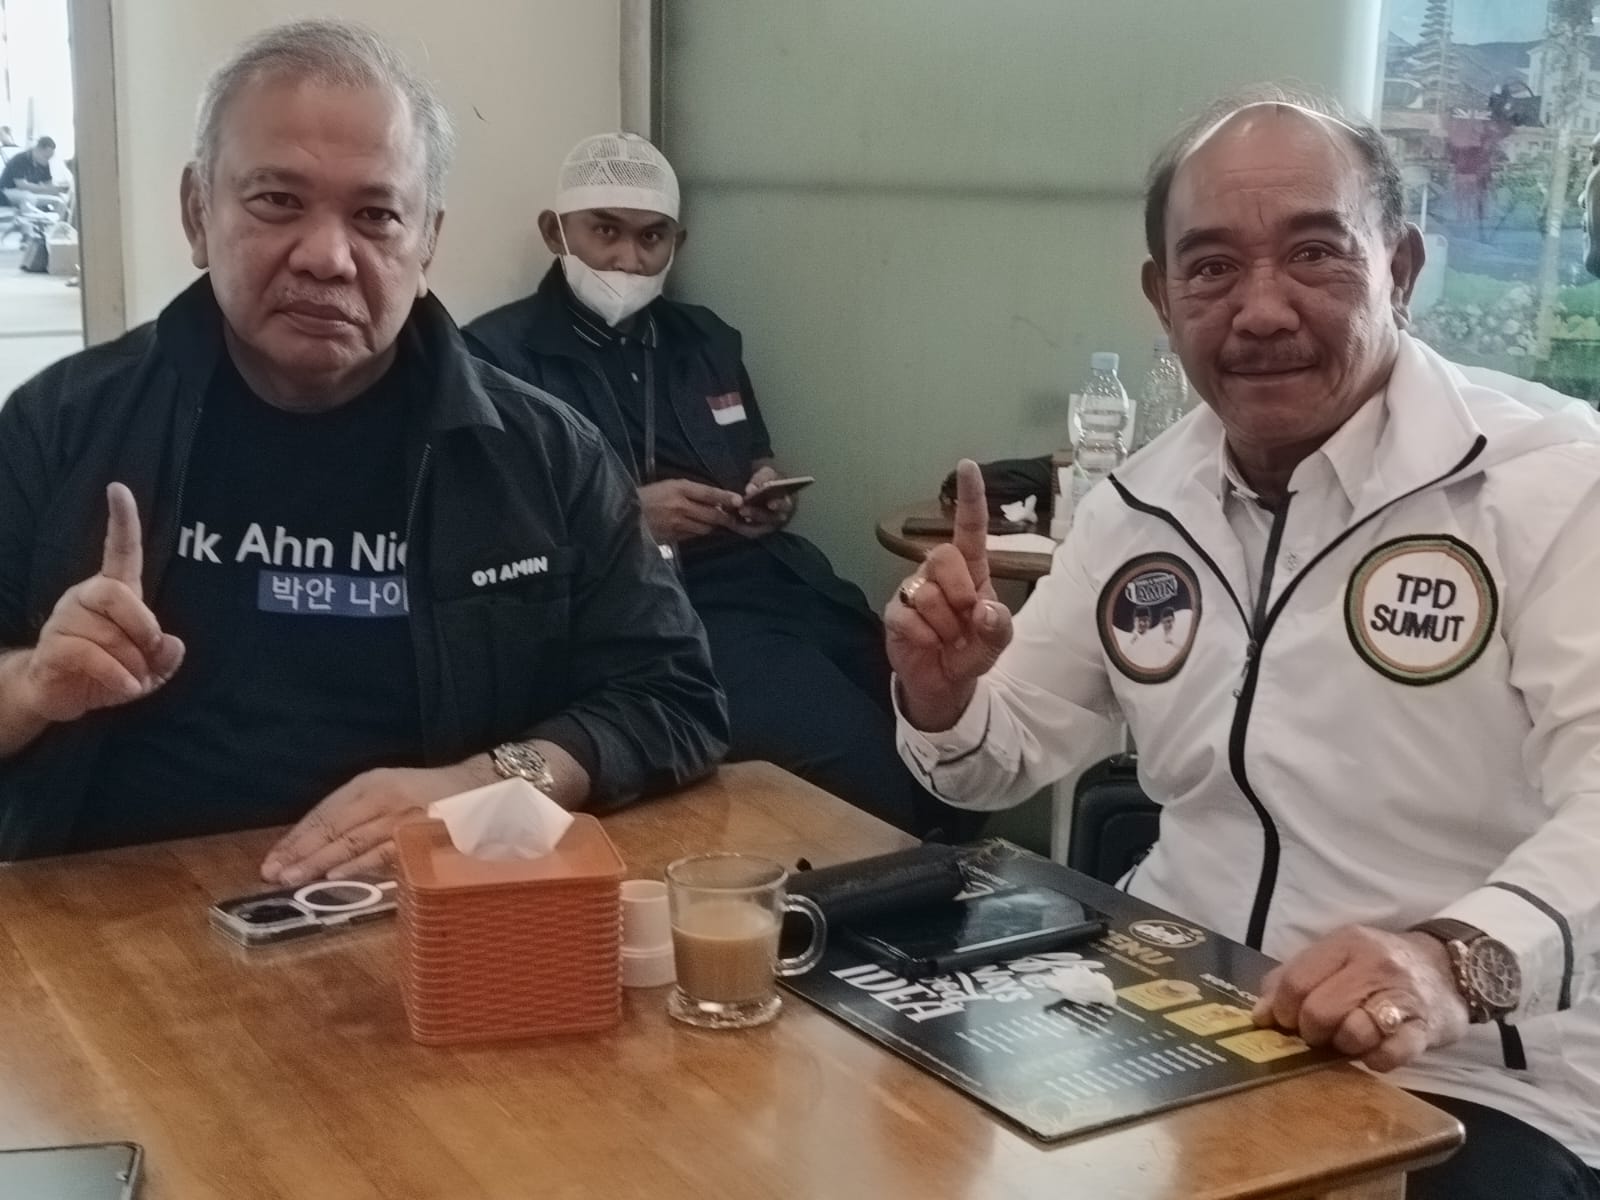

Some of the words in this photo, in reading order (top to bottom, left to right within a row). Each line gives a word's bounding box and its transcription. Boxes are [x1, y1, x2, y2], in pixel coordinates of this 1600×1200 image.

[177, 521, 223, 564] rk
[235, 522, 334, 568] Ahn
[471, 568, 497, 587] 01
[499, 555, 549, 582] AMIN
[272, 575, 337, 612] 박안
[349, 579, 409, 614] 나이
[1396, 573, 1457, 610] TPD
[1369, 603, 1465, 642] SUMUT
[1100, 928, 1175, 966] ENU
[828, 962, 967, 1024] IDEA
